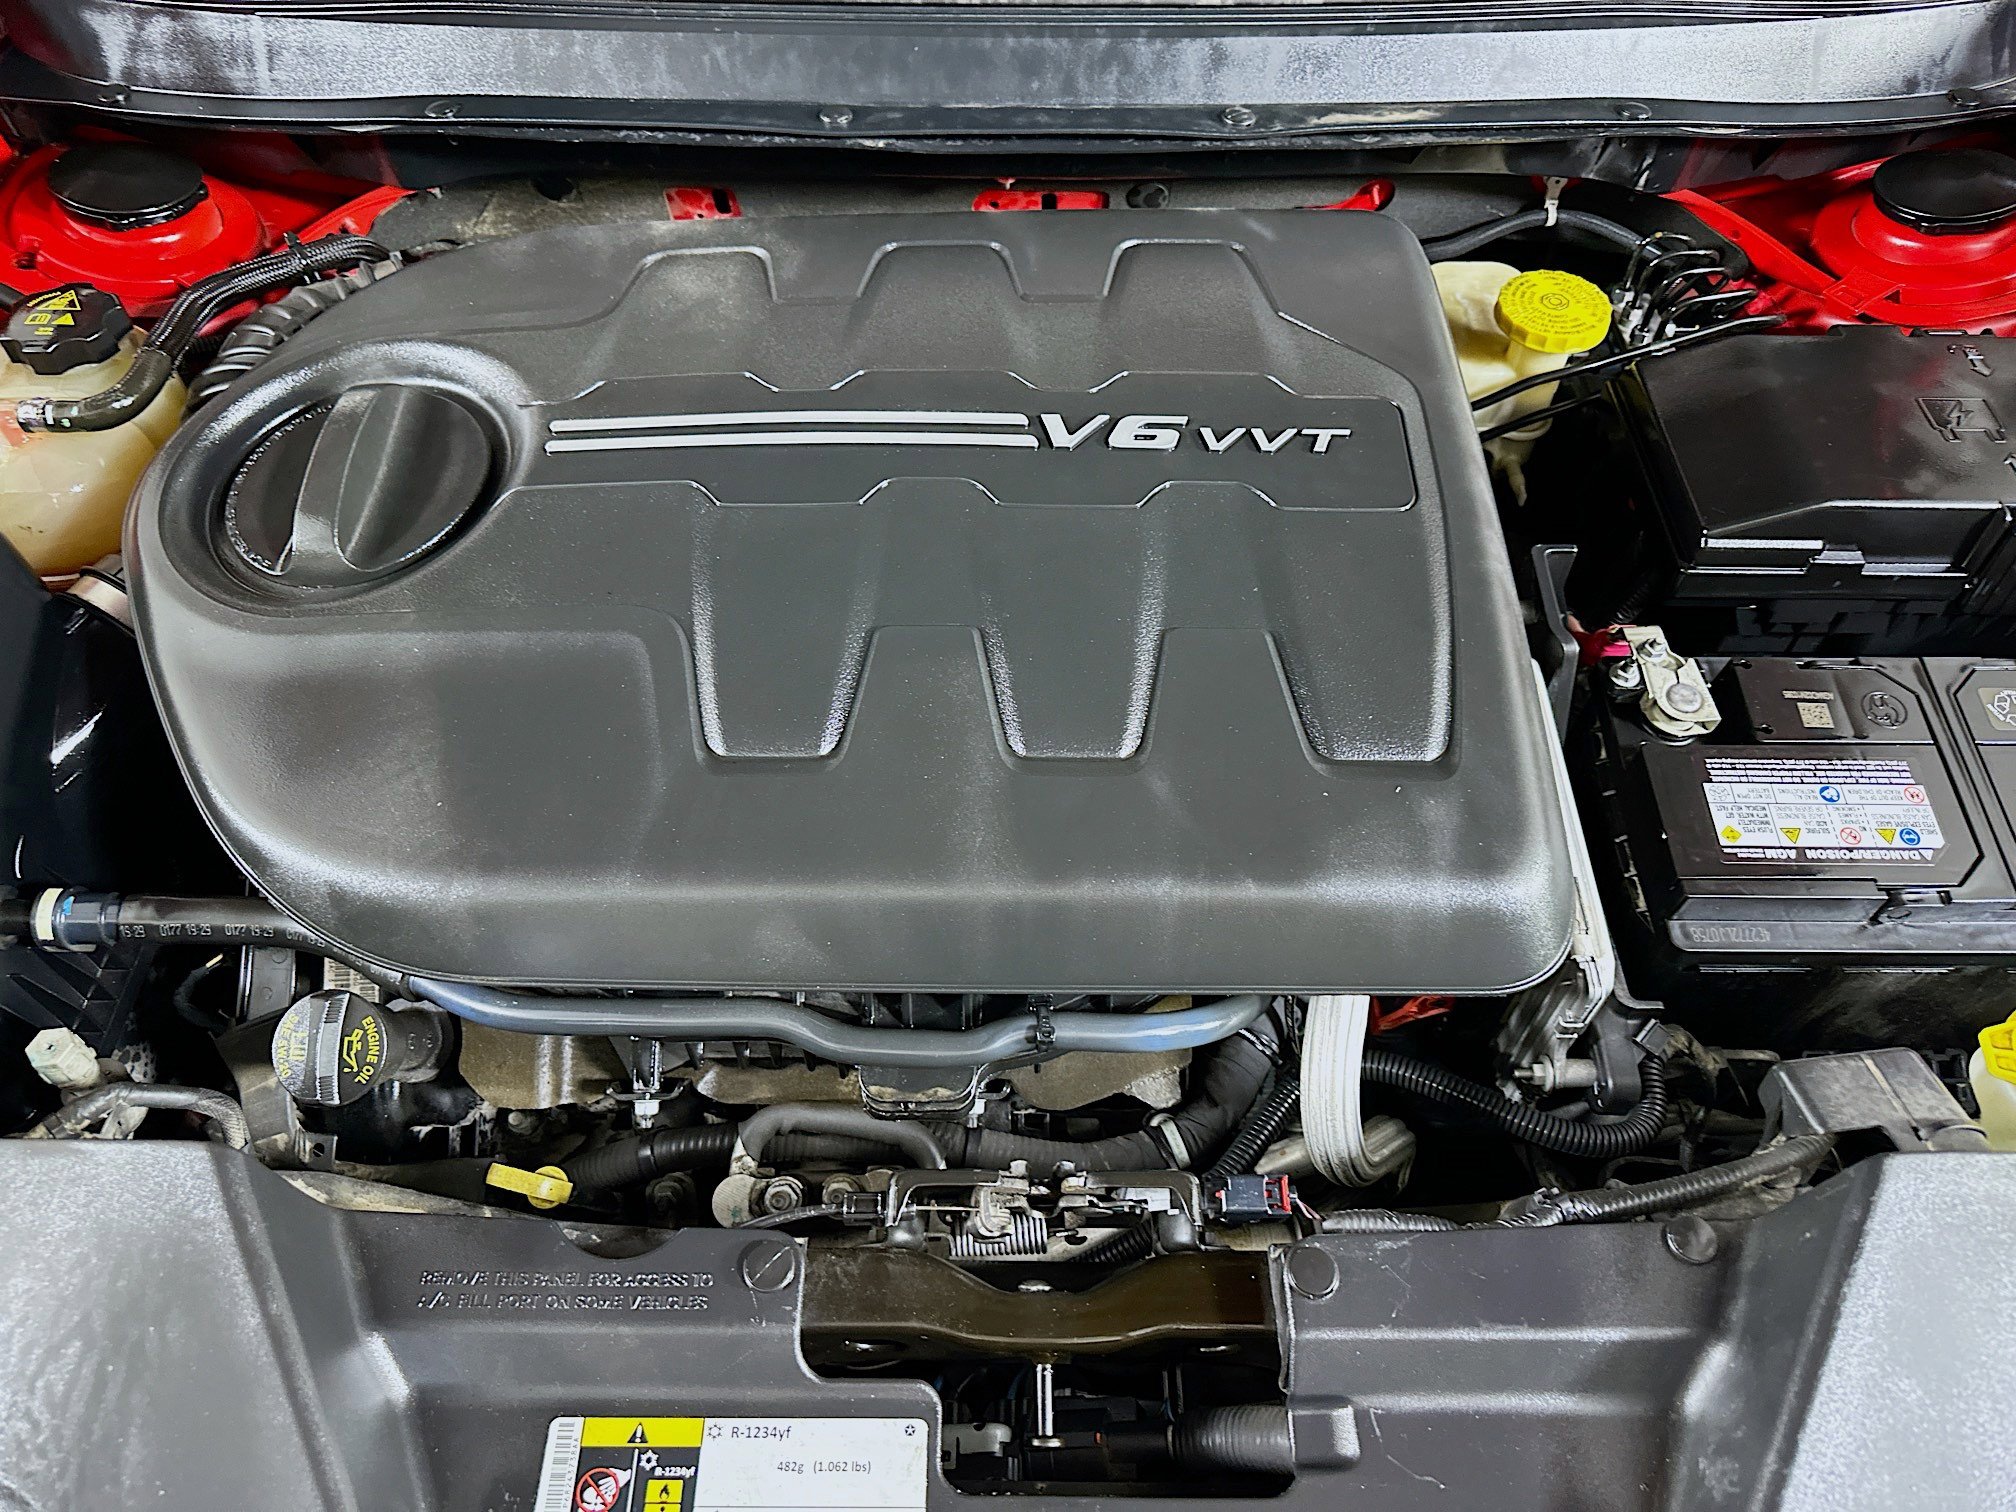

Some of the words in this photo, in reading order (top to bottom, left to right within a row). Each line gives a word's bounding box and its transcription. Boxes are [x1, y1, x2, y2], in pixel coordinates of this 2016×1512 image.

[1040, 413, 1189, 450] V6
[1199, 427, 1351, 454] VVT
[1764, 848, 1797, 859] AGM
[1805, 849, 1922, 860] DANGER/POISON
[361, 1015, 380, 1064] ENGINE
[354, 1065, 374, 1085] OIL
[420, 1270, 490, 1286] REMOVE
[494, 1270, 529, 1286] THIS
[532, 1271, 584, 1287] PANEL
[587, 1272, 622, 1287] FOR
[623, 1271, 689, 1288] ACCESS
[692, 1272, 714, 1288] TO
[458, 1293, 492, 1309] FILL
[497, 1293, 541, 1309] PORT
[545, 1293, 571, 1309] ON
[574, 1295, 624, 1310] SOME
[629, 1295, 710, 1310] VEHICLES
[731, 1426, 792, 1442] R-1234yf
[654, 1466, 696, 1479] R-1234yf
[777, 1461, 805, 1474] 482g
[813, 1460, 849, 1474] (1.062
[851, 1460, 872, 1474] lbs)
